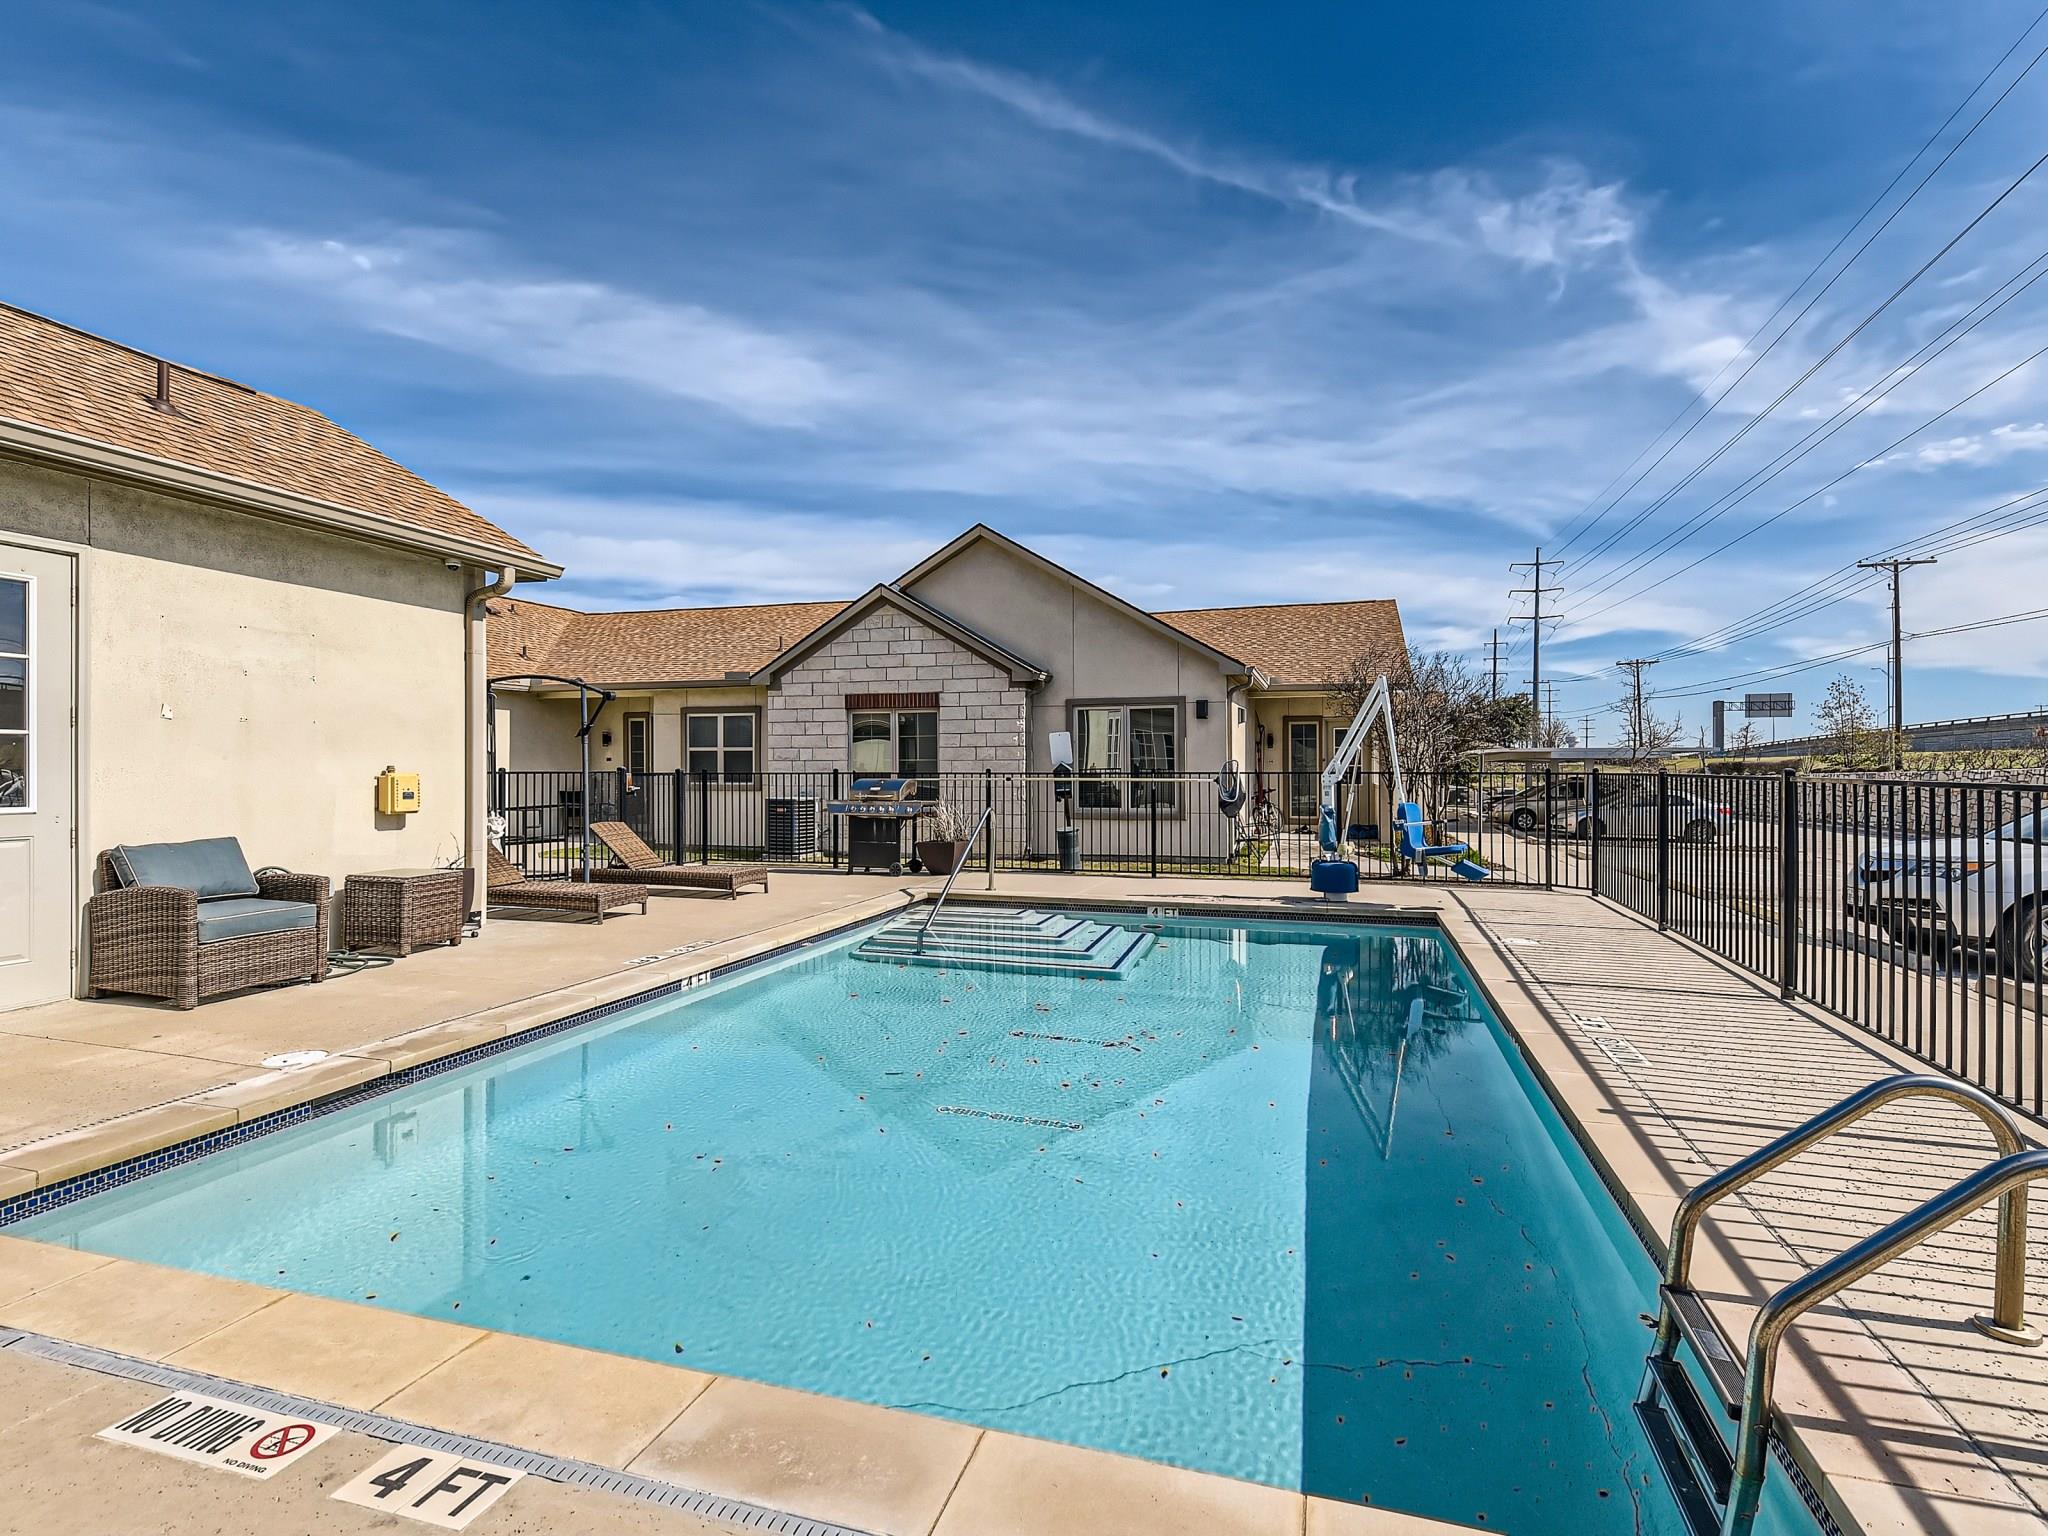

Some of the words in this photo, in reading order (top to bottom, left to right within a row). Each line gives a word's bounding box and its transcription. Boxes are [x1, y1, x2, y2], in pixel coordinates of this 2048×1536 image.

[1164, 908, 1177, 919] FT
[114, 1396, 192, 1434] NO
[150, 1405, 266, 1455] DIVING
[222, 1458, 238, 1467] NO
[236, 1461, 268, 1474] DIVING
[369, 1457, 433, 1499] 4
[411, 1466, 512, 1517] FT
